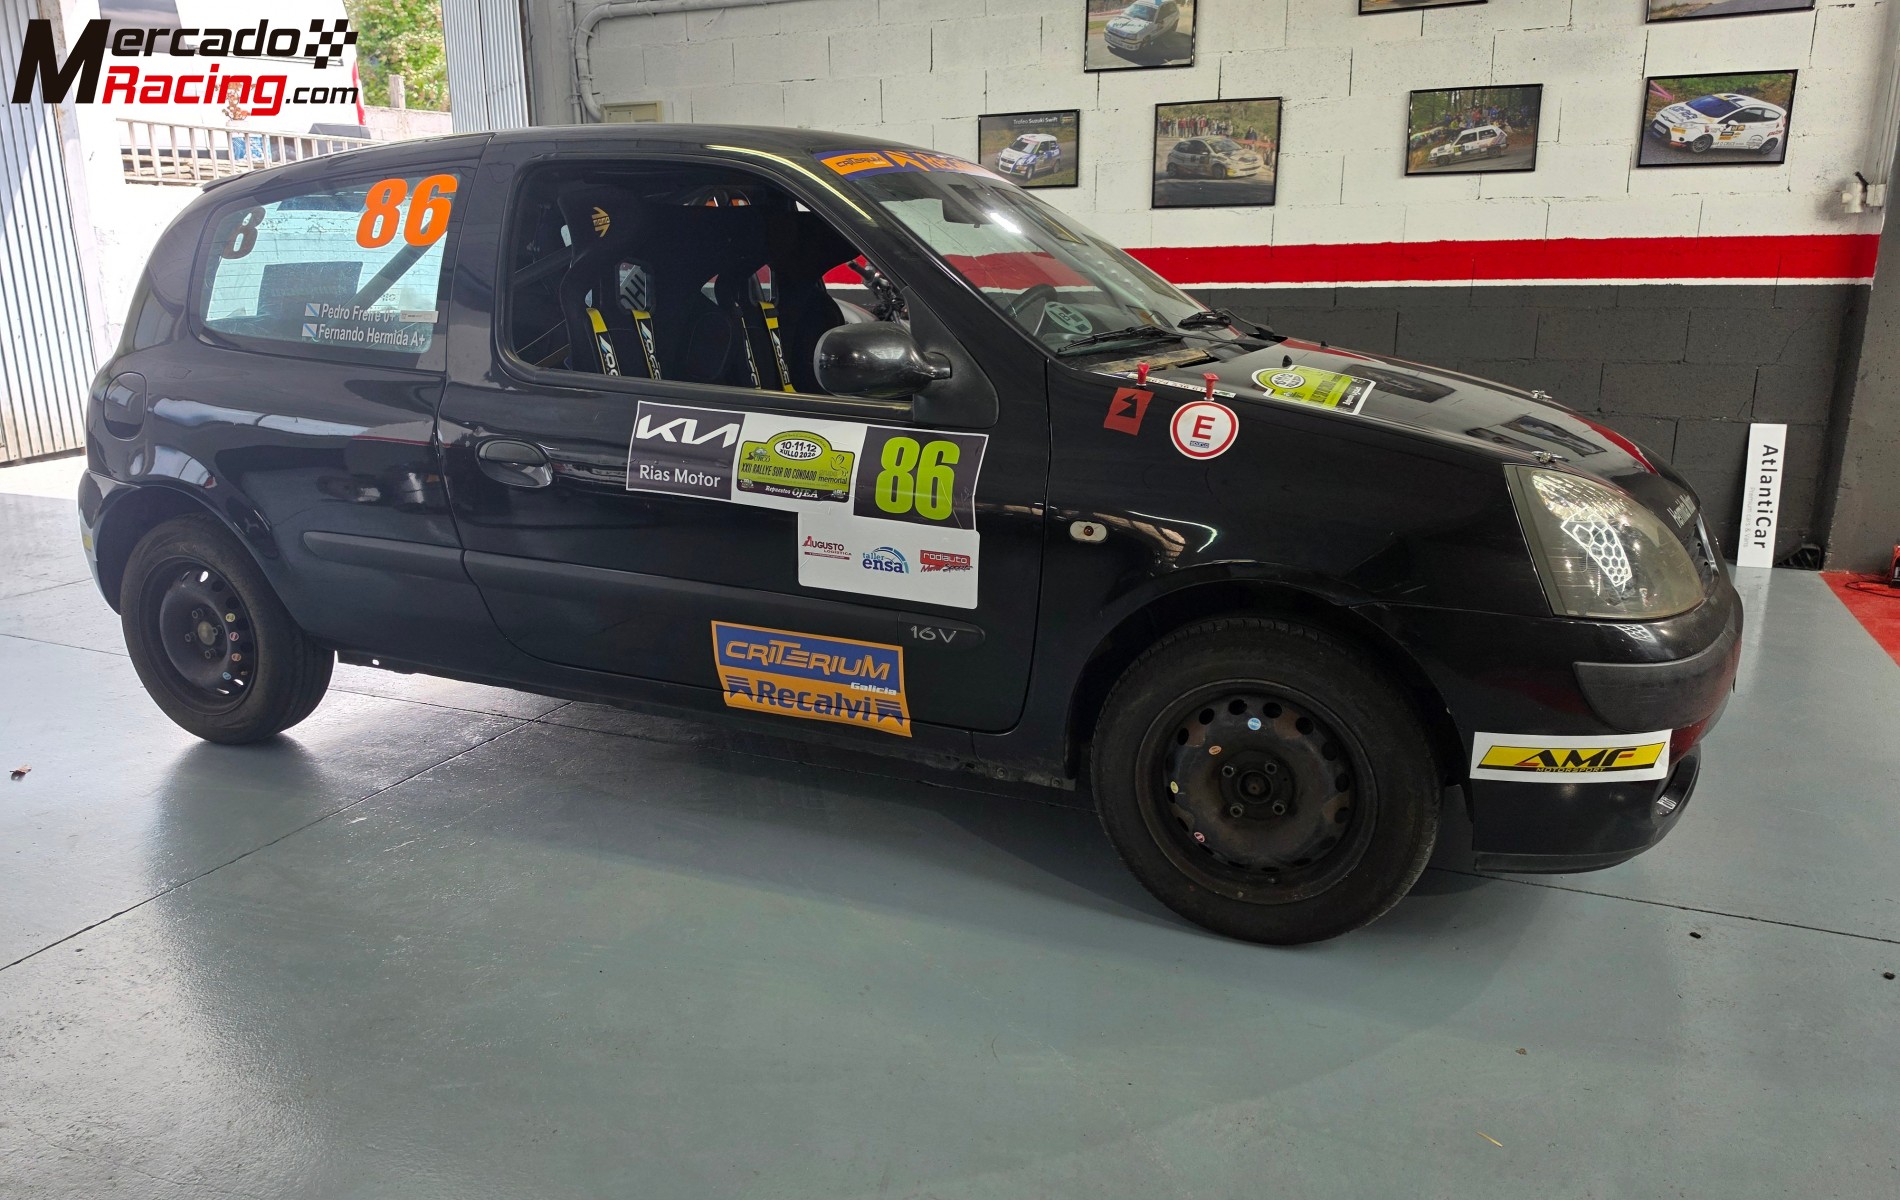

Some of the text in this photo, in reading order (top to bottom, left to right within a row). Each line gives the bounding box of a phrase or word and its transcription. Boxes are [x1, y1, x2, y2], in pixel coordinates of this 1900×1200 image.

[356, 173, 458, 249] 86
[321, 303, 350, 320] Pedro
[318, 323, 364, 342] Fernando
[366, 326, 408, 346] Hermida
[1192, 414, 1216, 441] E
[639, 465, 670, 482] Rias
[674, 468, 721, 488] Motor
[752, 463, 773, 476] RALLYE
[772, 466, 784, 477] SUR
[791, 468, 818, 482] CONDADO
[875, 436, 961, 521] 86
[1753, 444, 1779, 549] AtlantiCar
[802, 535, 845, 551] AUGUSTO
[862, 552, 885, 561] taller
[862, 558, 905, 574] ensa
[850, 681, 897, 696] Galicia
[756, 679, 872, 722] Recalvi
